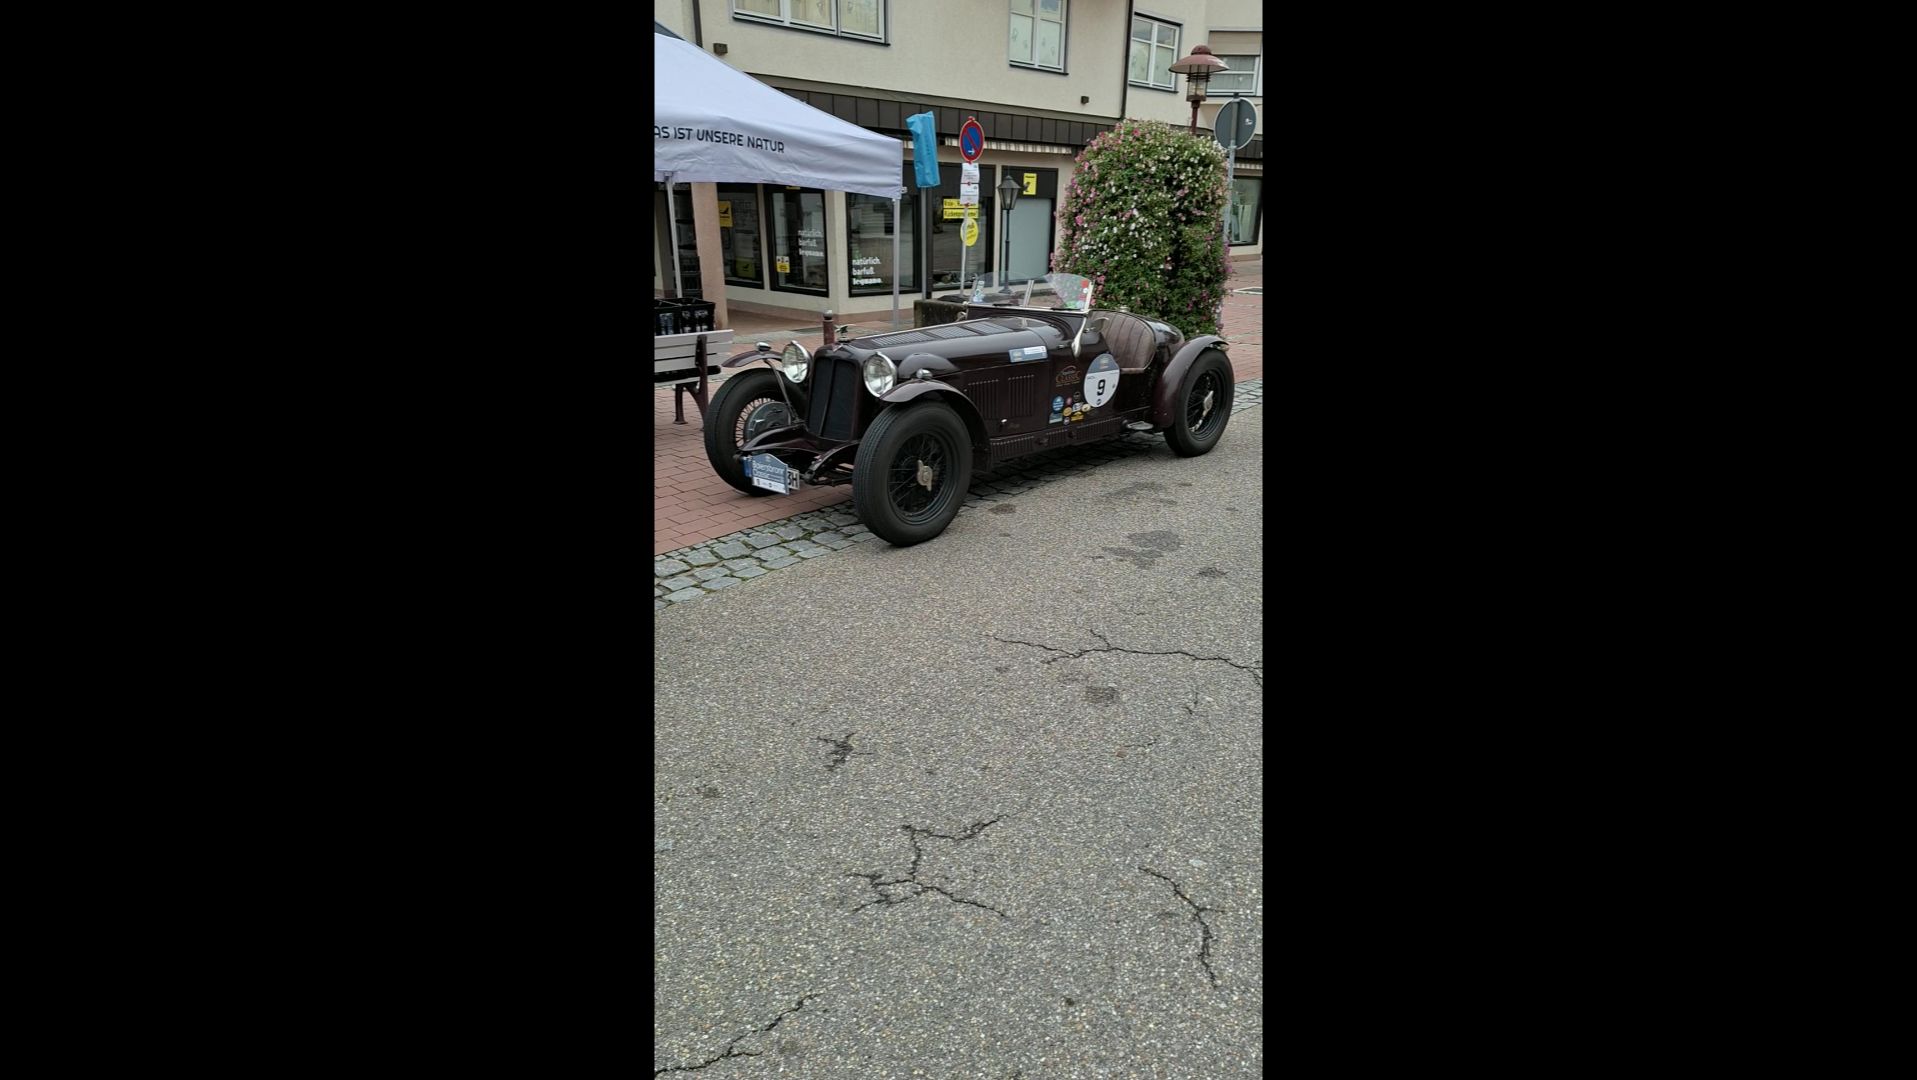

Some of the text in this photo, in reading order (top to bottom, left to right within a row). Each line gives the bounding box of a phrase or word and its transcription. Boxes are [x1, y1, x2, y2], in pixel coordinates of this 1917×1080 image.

[674, 127, 693, 140] IST
[696, 129, 744, 146] UNSERE
[747, 135, 785, 153] NATUR
[1097, 379, 1106, 396] 9
